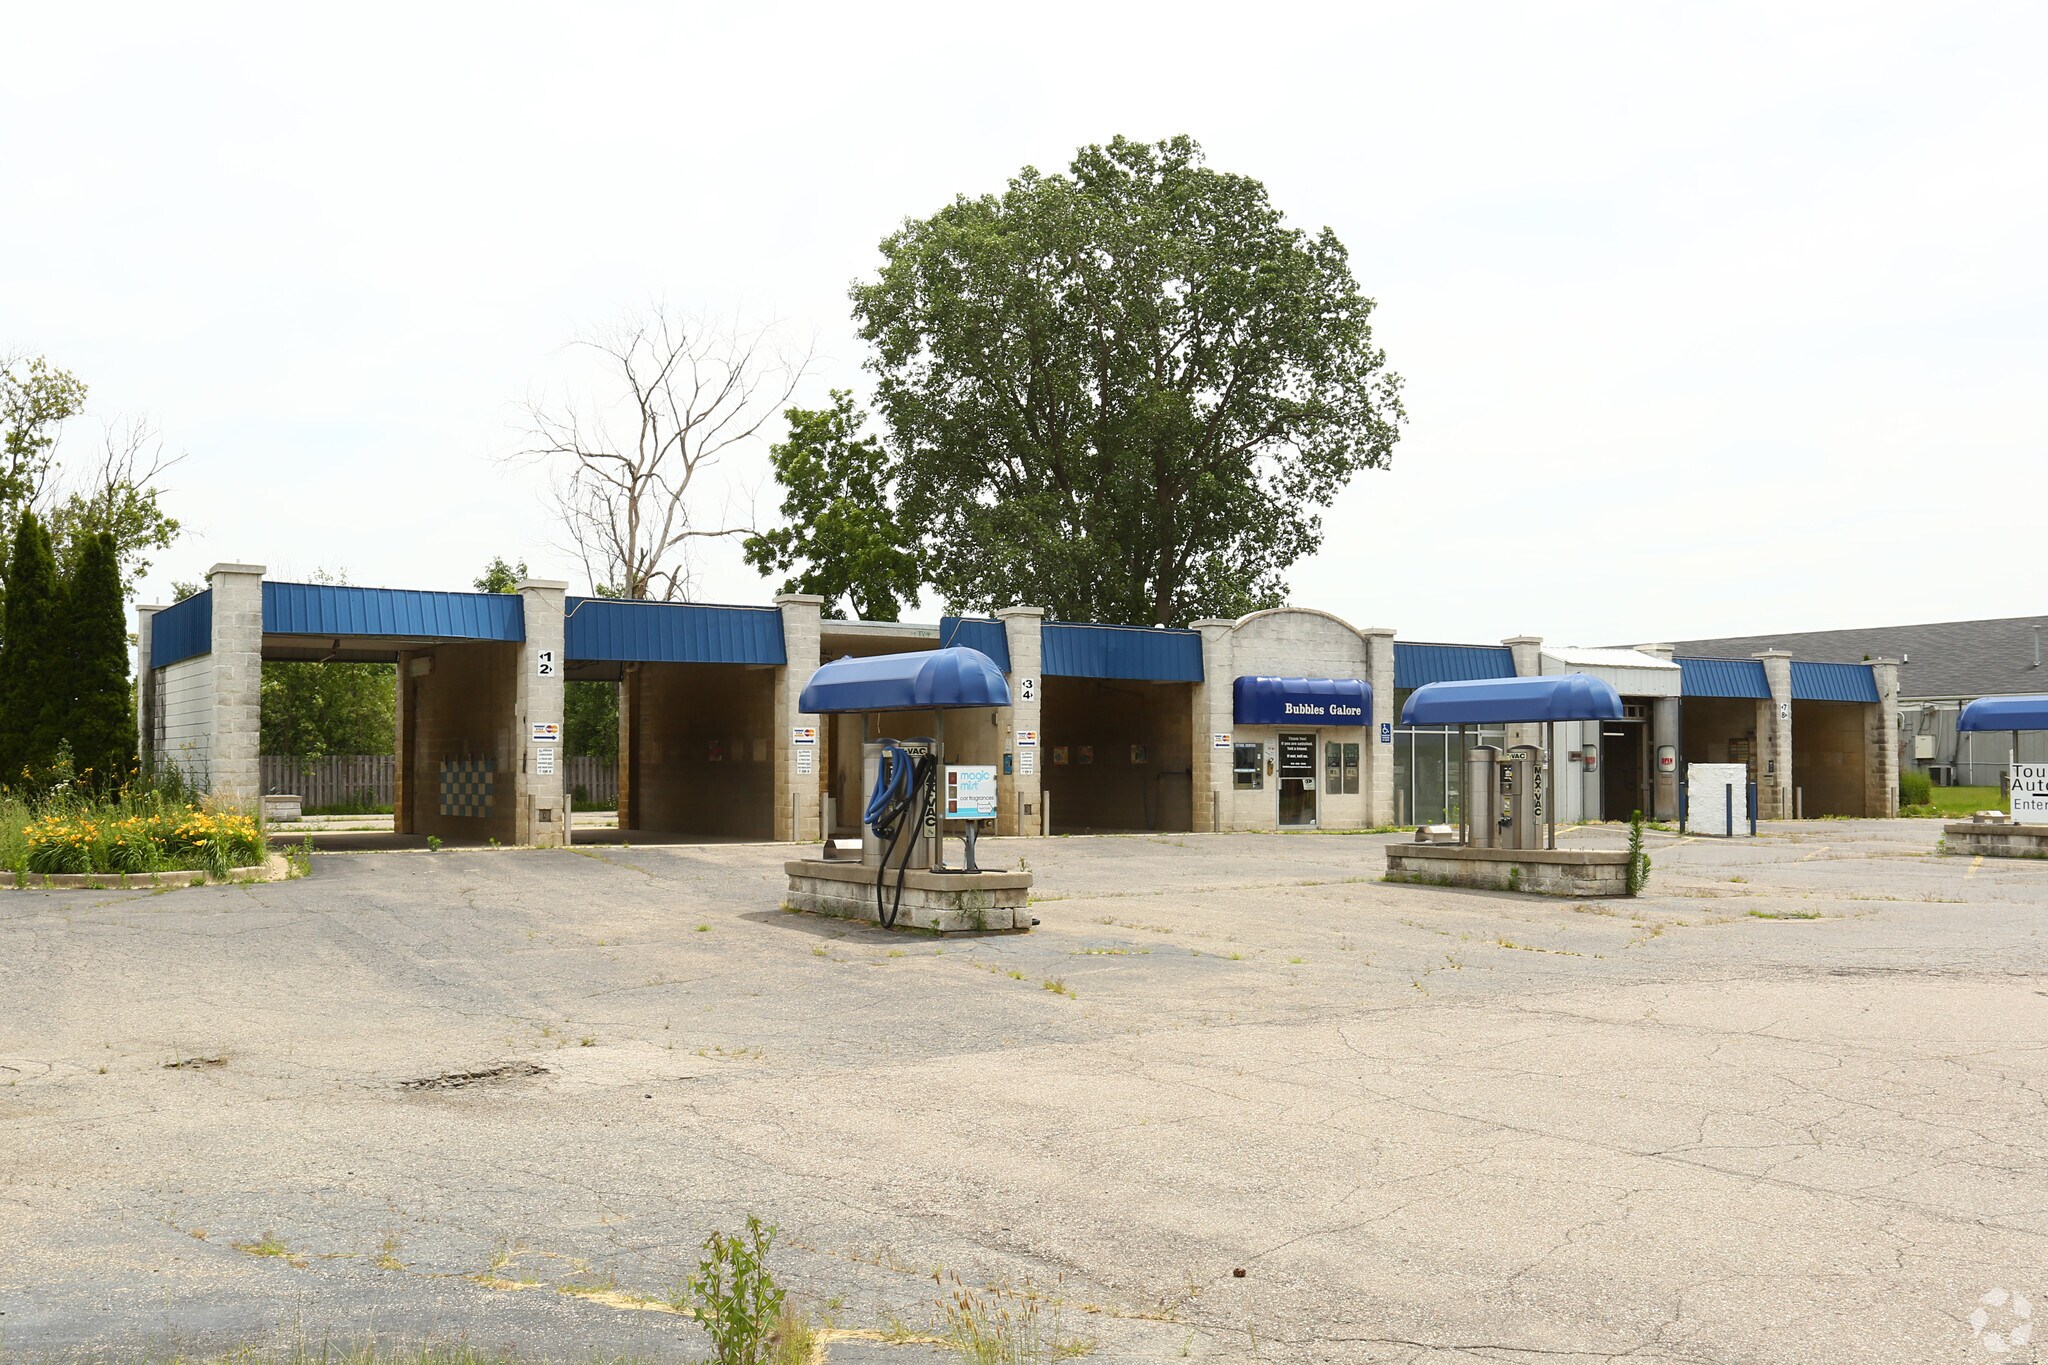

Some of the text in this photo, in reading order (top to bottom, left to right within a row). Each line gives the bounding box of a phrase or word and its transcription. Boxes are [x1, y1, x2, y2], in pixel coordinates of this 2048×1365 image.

[544, 652, 551, 662] 1
[540, 664, 549, 674] 2
[1025, 680, 1033, 689] 3
[1022, 691, 1030, 699] 4
[1285, 703, 1362, 716] Bubbles Galore
[960, 770, 990, 782] magic
[2012, 765, 2045, 778] Tou
[960, 780, 978, 790] mist
[2012, 778, 2048, 791] Aut
